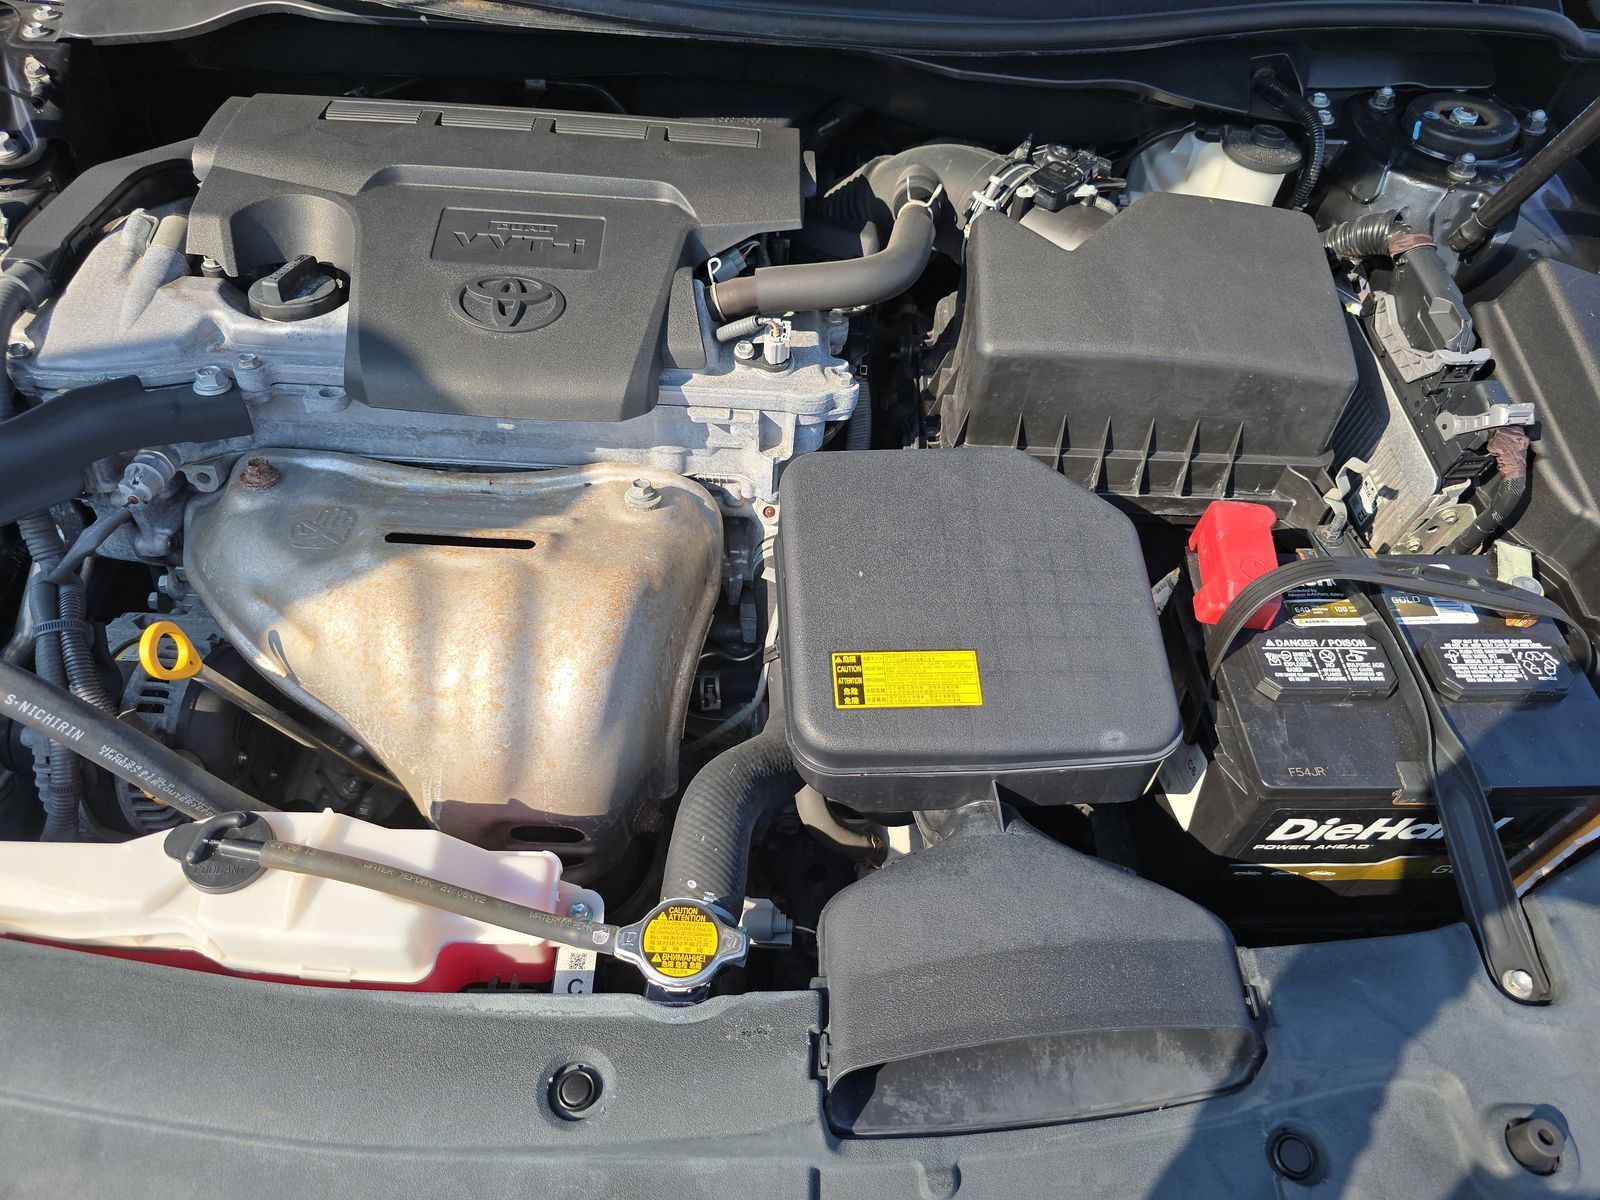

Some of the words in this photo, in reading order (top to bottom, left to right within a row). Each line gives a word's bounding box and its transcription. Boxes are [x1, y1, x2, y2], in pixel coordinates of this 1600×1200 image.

[453, 231, 586, 255] VVT-i
[1391, 596, 1420, 604] GOLD
[1274, 639, 1318, 647] DANGER
[1327, 639, 1367, 647] POISON
[837, 665, 862, 673] CAUTION
[838, 677, 863, 685] ATTENTION
[1288, 767, 1326, 777] F54JR
[363, 862, 395, 876] WATER
[668, 906, 699, 915] CAUTION
[529, 911, 559, 925] WATER
[668, 914, 706, 922] ATTENTION
[662, 953, 706, 962] ВНИМАНИЕ!
[567, 978, 584, 993] C
